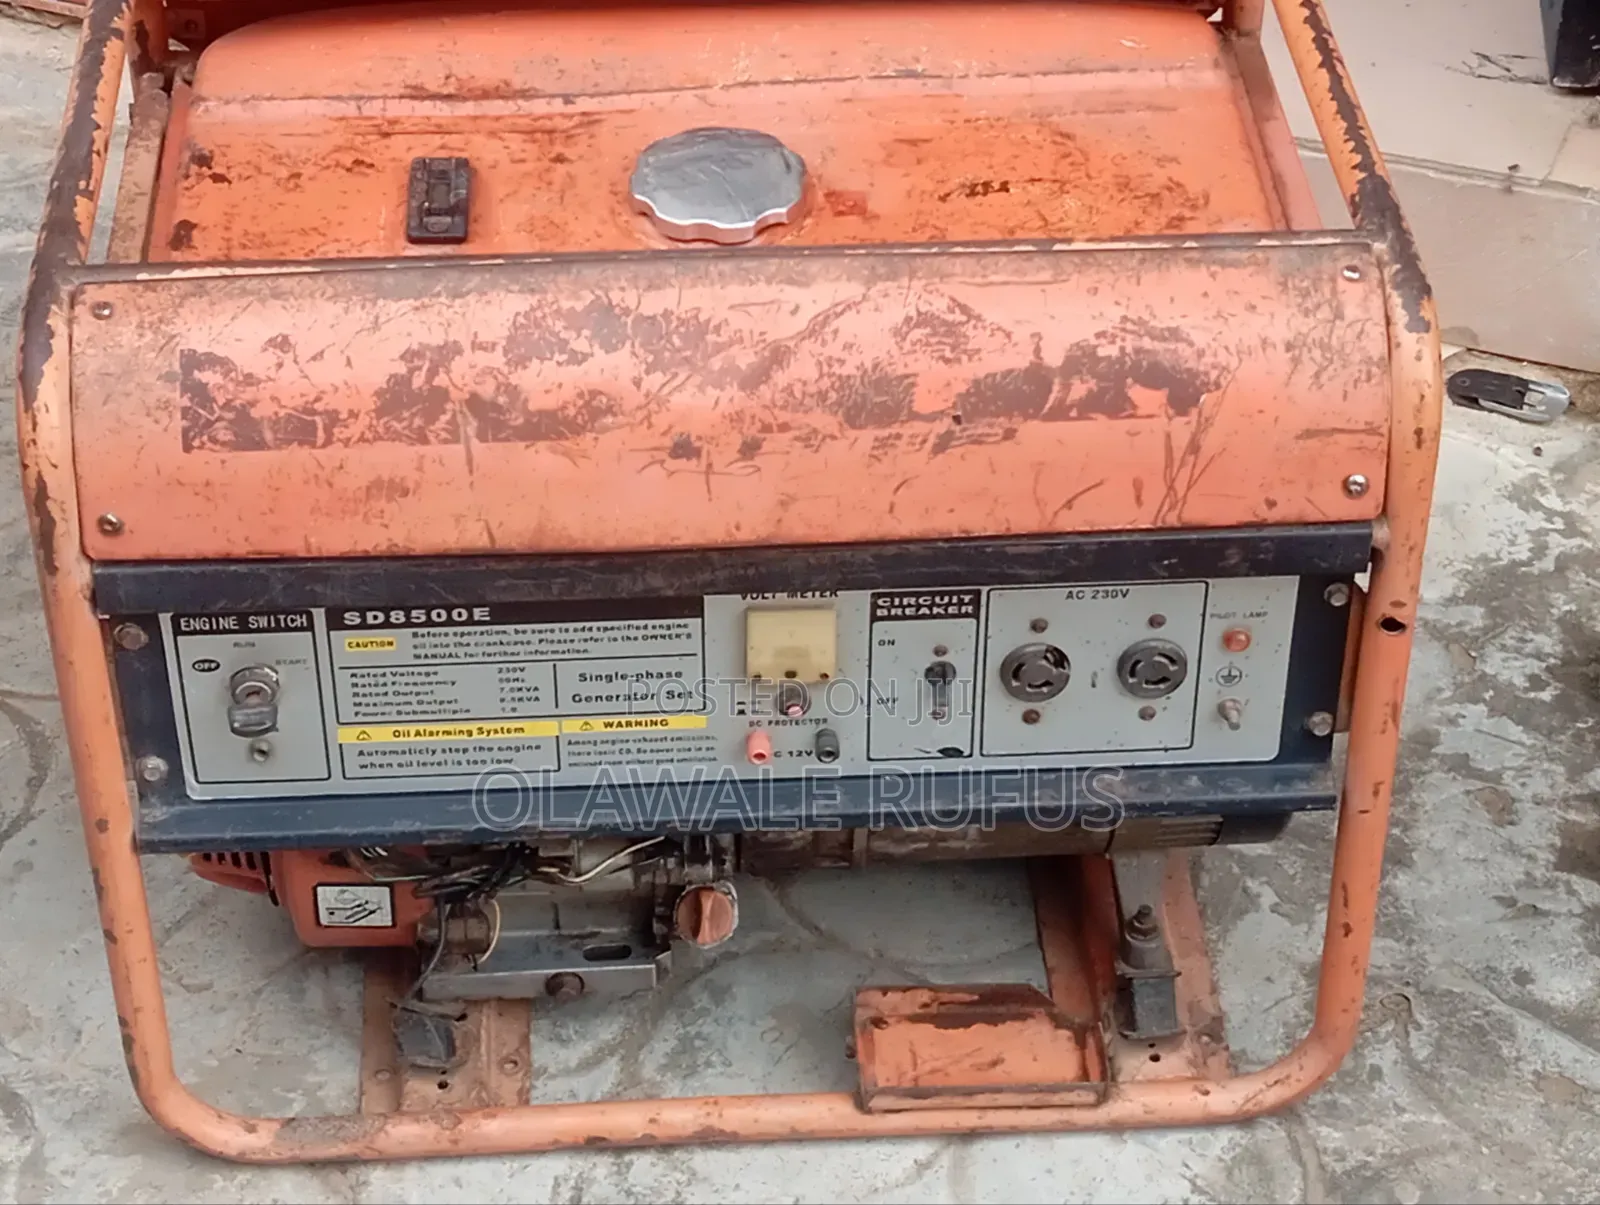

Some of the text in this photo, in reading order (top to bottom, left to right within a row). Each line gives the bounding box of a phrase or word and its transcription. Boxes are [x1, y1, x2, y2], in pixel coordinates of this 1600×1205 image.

[1065, 587, 1131, 600] AC 230V
[876, 594, 975, 607] CIRCUIT
[343, 606, 491, 625] SD8500E
[876, 605, 974, 617] BREAKER
[180, 613, 308, 631] ENGINE SWITCH
[412, 630, 450, 639] Before
[514, 627, 528, 636] be
[531, 626, 556, 635] sure
[559, 626, 570, 634] to
[573, 625, 594, 633] add
[596, 623, 649, 634] specified
[651, 621, 690, 632] engine
[347, 640, 394, 649] CAUTION
[453, 640, 471, 648] the
[621, 634, 639, 643] the
[877, 639, 896, 647] ON
[413, 651, 461, 660] MANUAL
[194, 662, 218, 671] OFF
[350, 671, 387, 679] Rated
[390, 670, 439, 678] Voltage
[578, 669, 683, 684] Single-phase
[351, 681, 388, 689] Rated
[352, 690, 389, 698] Rated
[571, 689, 694, 704] Generator Set
[416, 698, 458, 706] Output
[602, 718, 669, 730] WARNING
[749, 717, 828, 728] DC PROTECTOR
[392, 725, 526, 739] Oil Alarming System
[441, 746, 469, 756] stop
[473, 745, 495, 753] the
[498, 743, 542, 752] engine
[788, 749, 814, 758] 12V
[358, 761, 394, 770] when
[398, 760, 414, 769] oil
[417, 758, 449, 767] level
[452, 758, 463, 767] is
[466, 758, 487, 766] too
